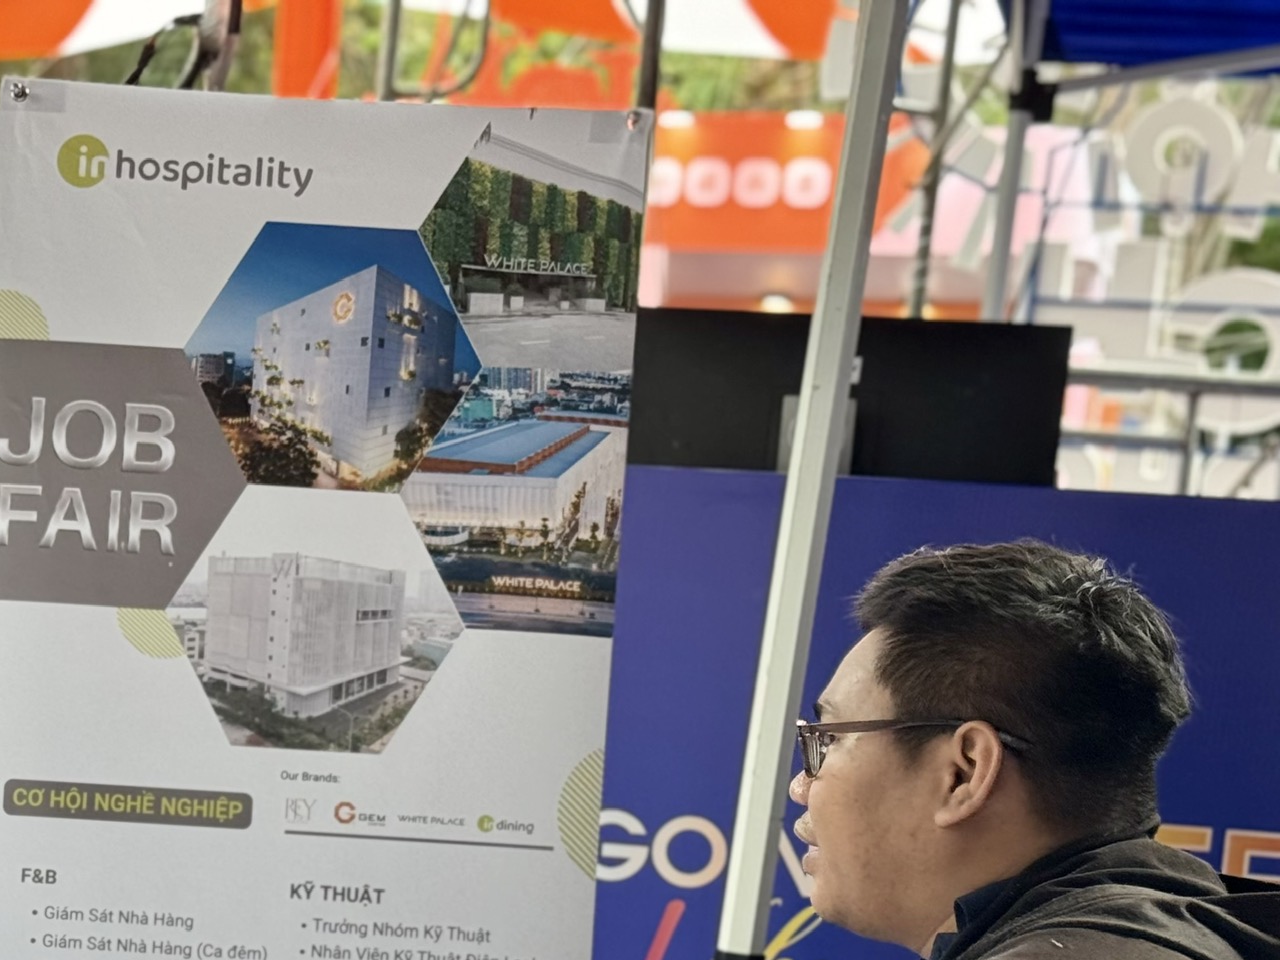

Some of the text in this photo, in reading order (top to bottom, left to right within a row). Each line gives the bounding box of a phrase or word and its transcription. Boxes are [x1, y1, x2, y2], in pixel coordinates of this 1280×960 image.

[116, 149, 313, 197] hospitality
[484, 253, 588, 274] WHITE PALACE
[492, 576, 581, 591] WHITE PALACE
[281, 771, 340, 783] Our Brands:
[13, 787, 243, 822] CƠ HỘI NGHỀ NGHIỆP
[397, 815, 465, 826] WHITE PALACE
[496, 820, 534, 835] dining
[21, 868, 57, 884] F&B
[291, 881, 385, 907] KỸ THUẬT
[44, 905, 194, 931] Giám Sát Nhà Hàng
[313, 918, 490, 945] Trưởng Nhóm Kỹ Thuật
[42, 934, 82, 949] Giám
[87, 936, 112, 951] Sát
[117, 939, 147, 953] Nhà
[152, 941, 192, 959] Hàng
[197, 942, 222, 960] (Ca
[311, 944, 351, 960] Nhân
